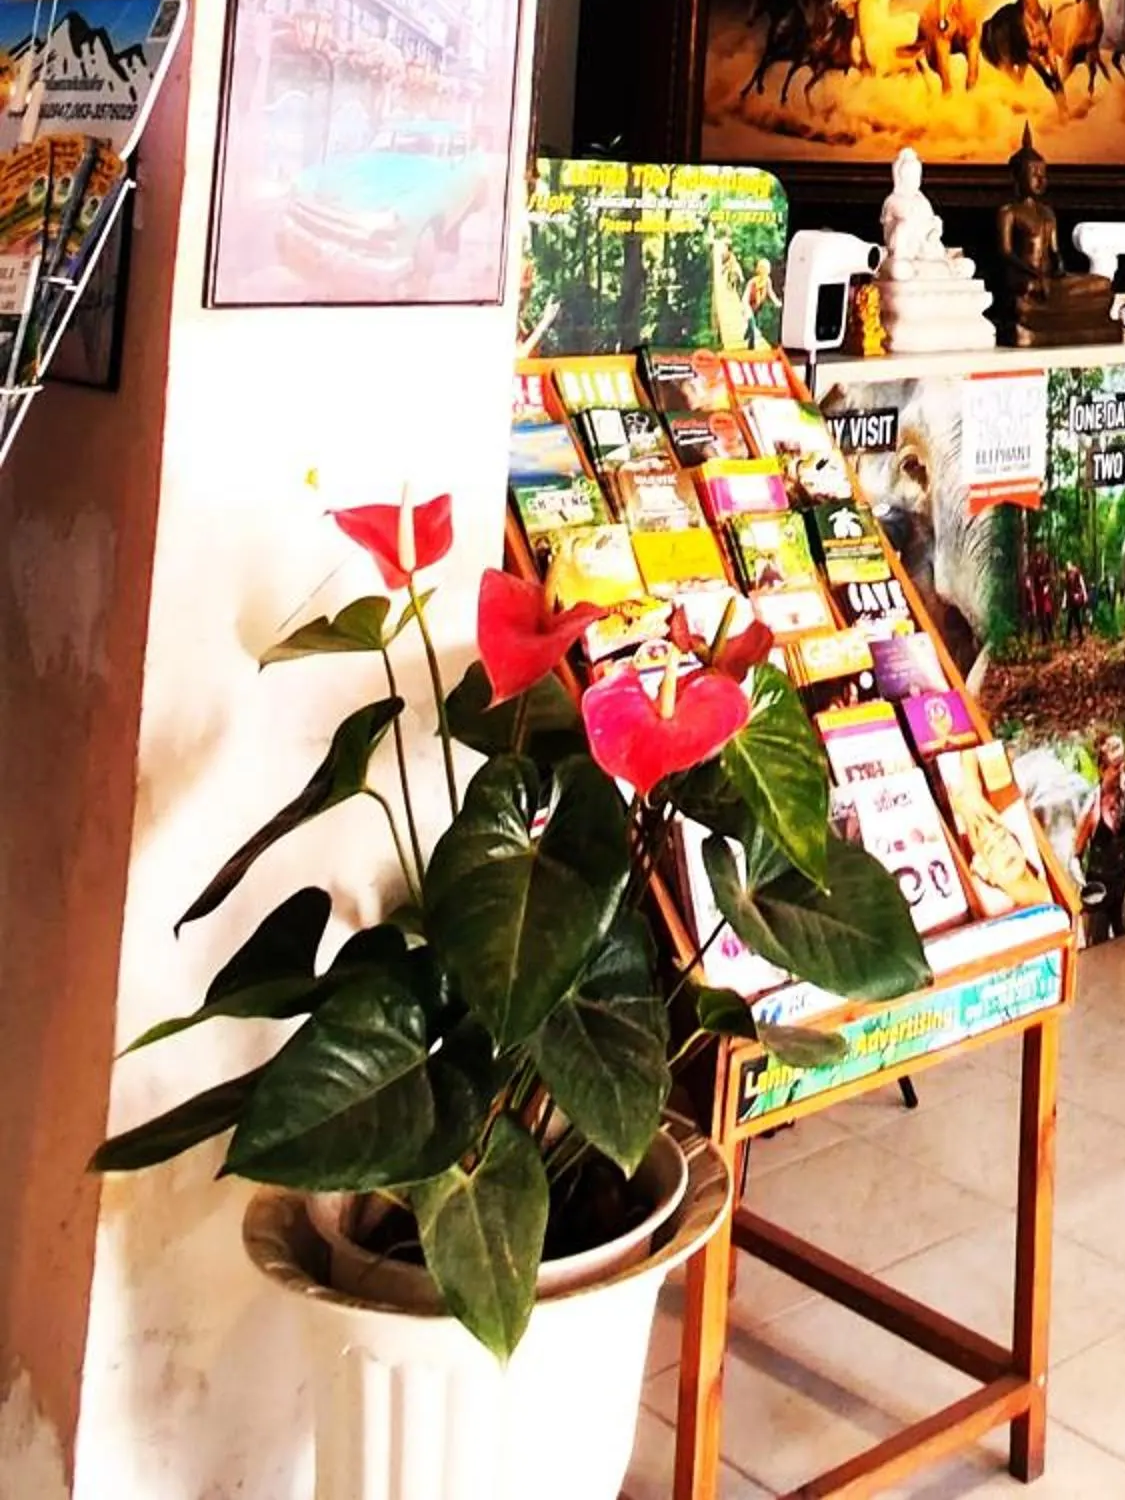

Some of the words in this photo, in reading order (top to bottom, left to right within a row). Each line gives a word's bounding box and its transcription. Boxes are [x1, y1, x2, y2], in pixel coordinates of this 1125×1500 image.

[850, 415, 895, 447] VISIT
[1075, 402, 1103, 432] ONE
[1093, 452, 1123, 481] TWO
